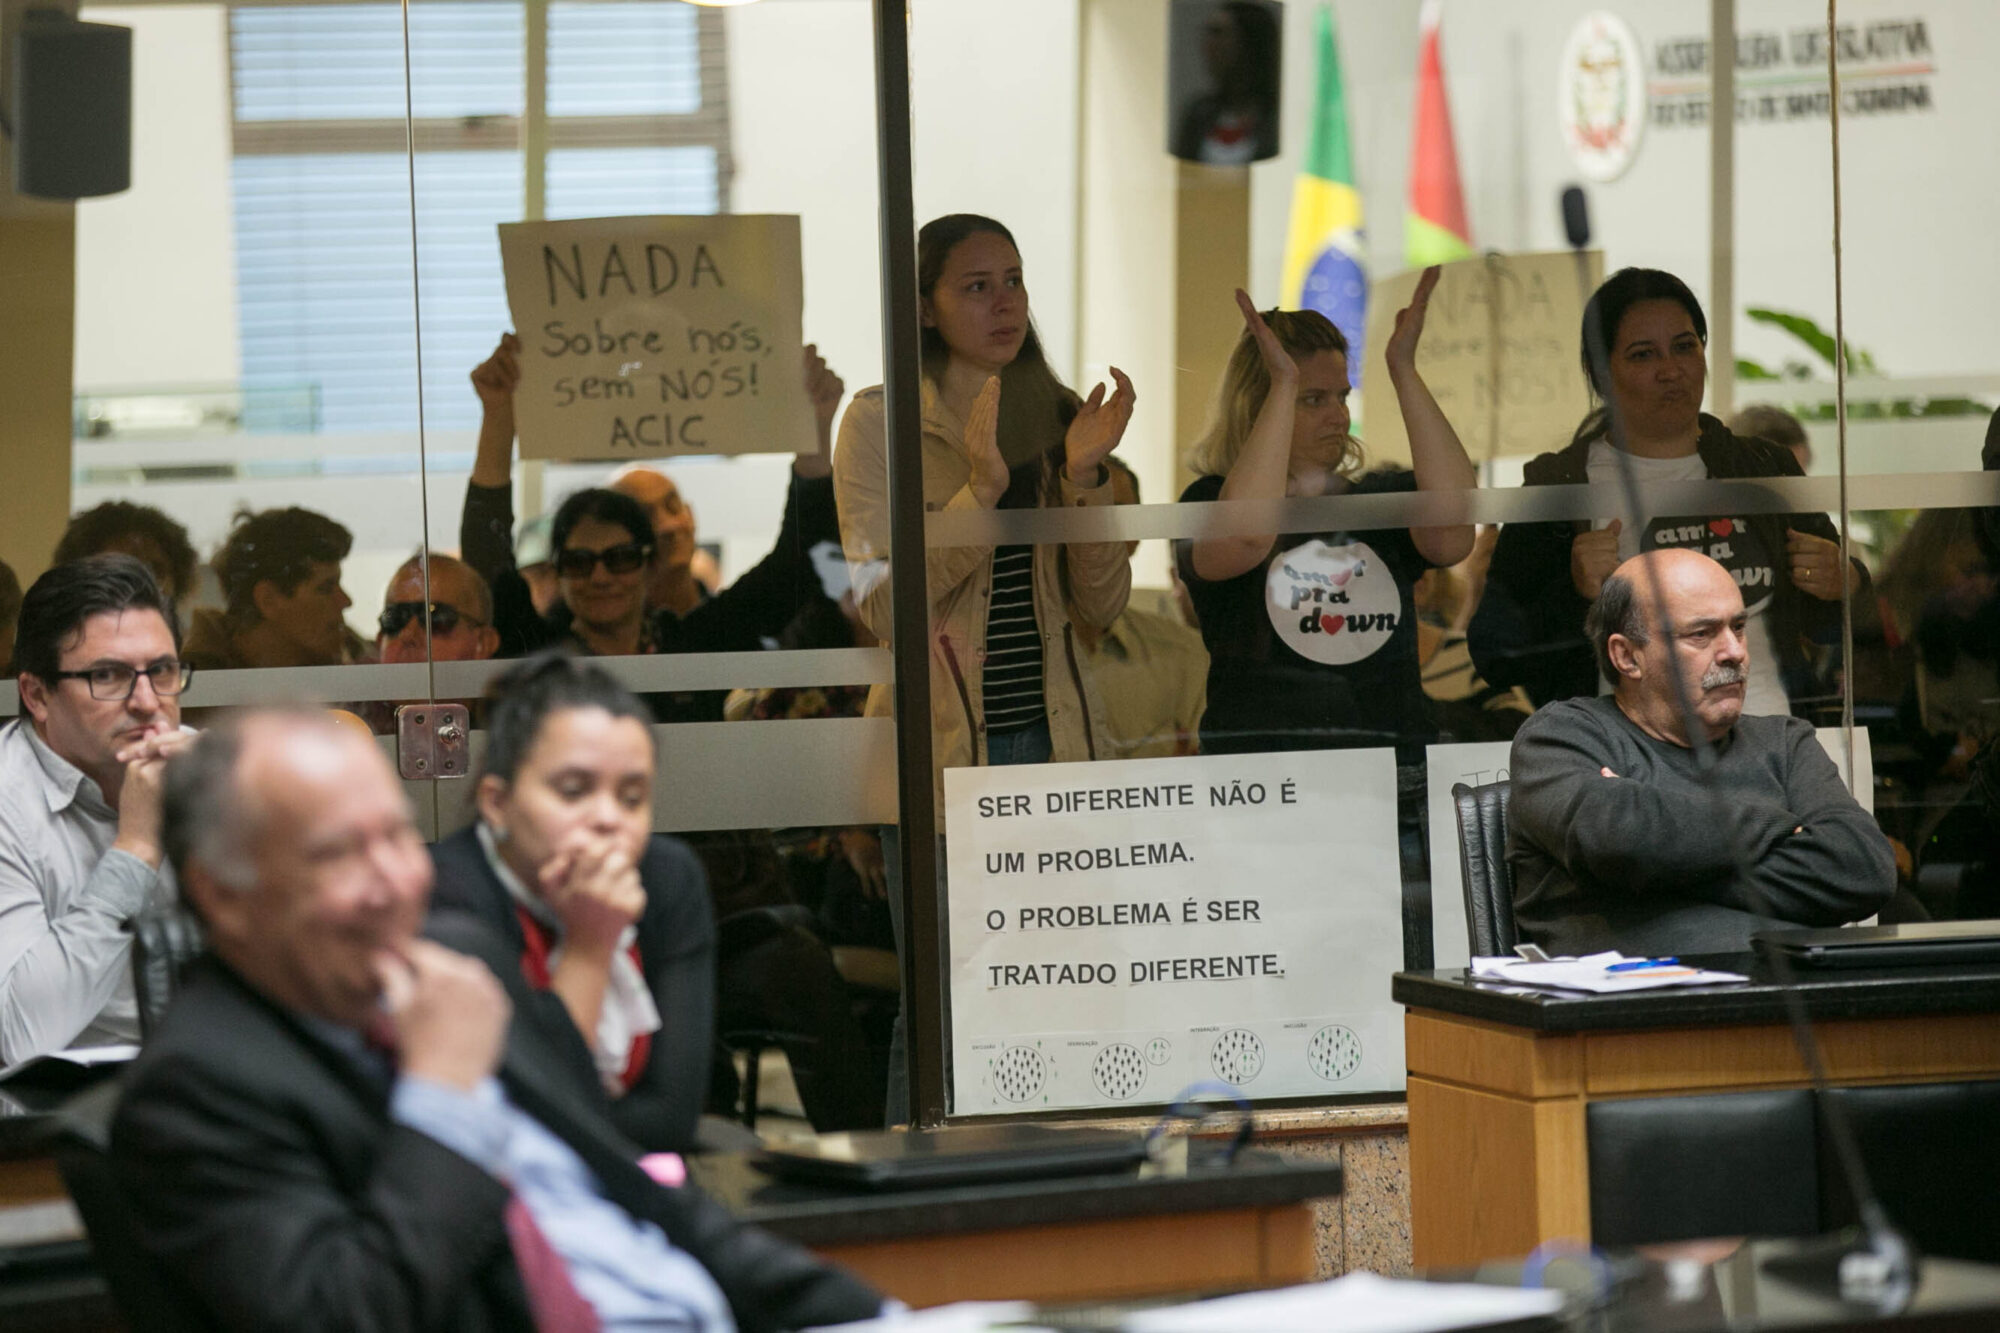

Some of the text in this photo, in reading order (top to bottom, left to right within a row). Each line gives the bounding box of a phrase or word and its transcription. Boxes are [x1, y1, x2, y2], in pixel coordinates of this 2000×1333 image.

[543, 243, 725, 308] NADA
[541, 318, 772, 358] Sobre nós,
[553, 358, 759, 407] sem NÓS!
[609, 413, 708, 448] ACIC
[1290, 585, 1350, 610] pra
[978, 778, 1298, 818] SER DIFERENTE NÃO É
[985, 841, 1195, 874] UM PROBLEMA.
[985, 897, 1261, 931] O PROBLEMA É SER
[988, 954, 1286, 986] TRATADO DIFERENTE.
